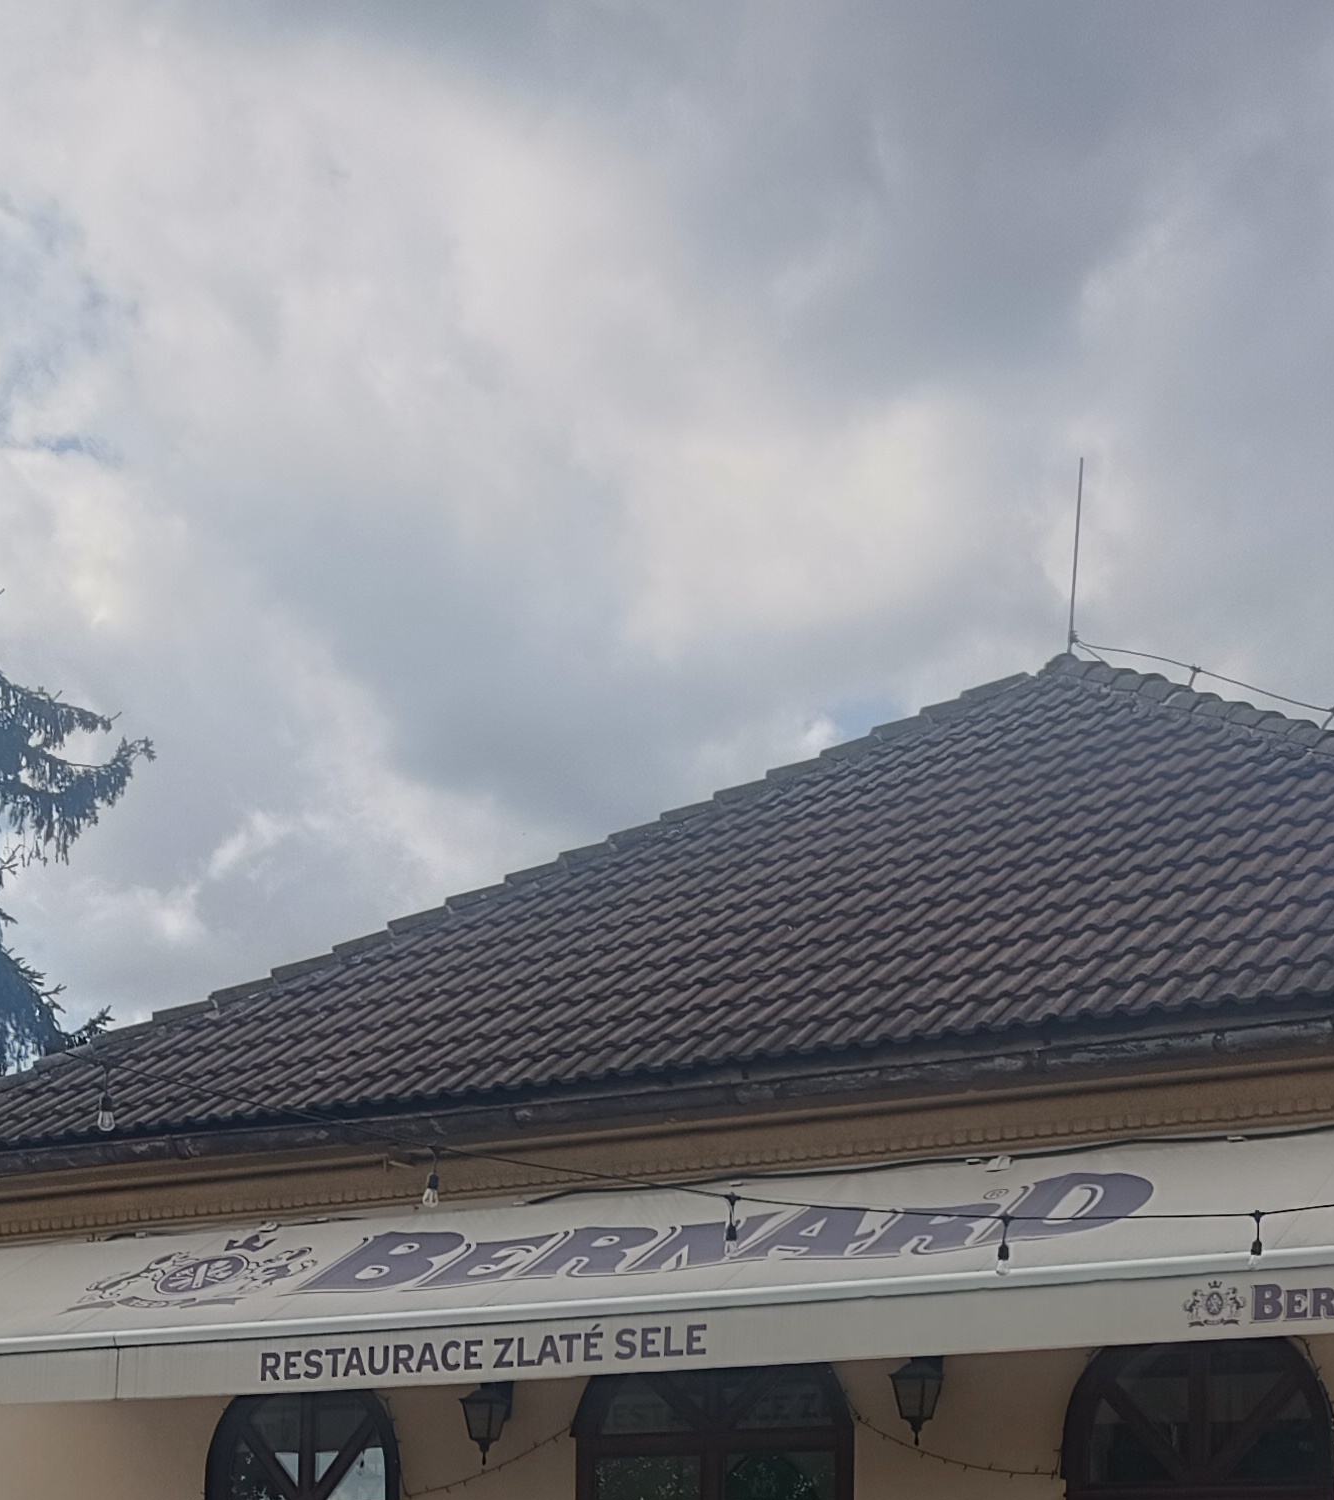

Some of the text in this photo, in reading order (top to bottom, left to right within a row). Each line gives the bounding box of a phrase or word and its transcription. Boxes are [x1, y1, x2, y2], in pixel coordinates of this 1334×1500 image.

[285, 1172, 1155, 1293] BERNARD
[260, 1323, 707, 1381] RESTAURACE ZLATÉ SELE
